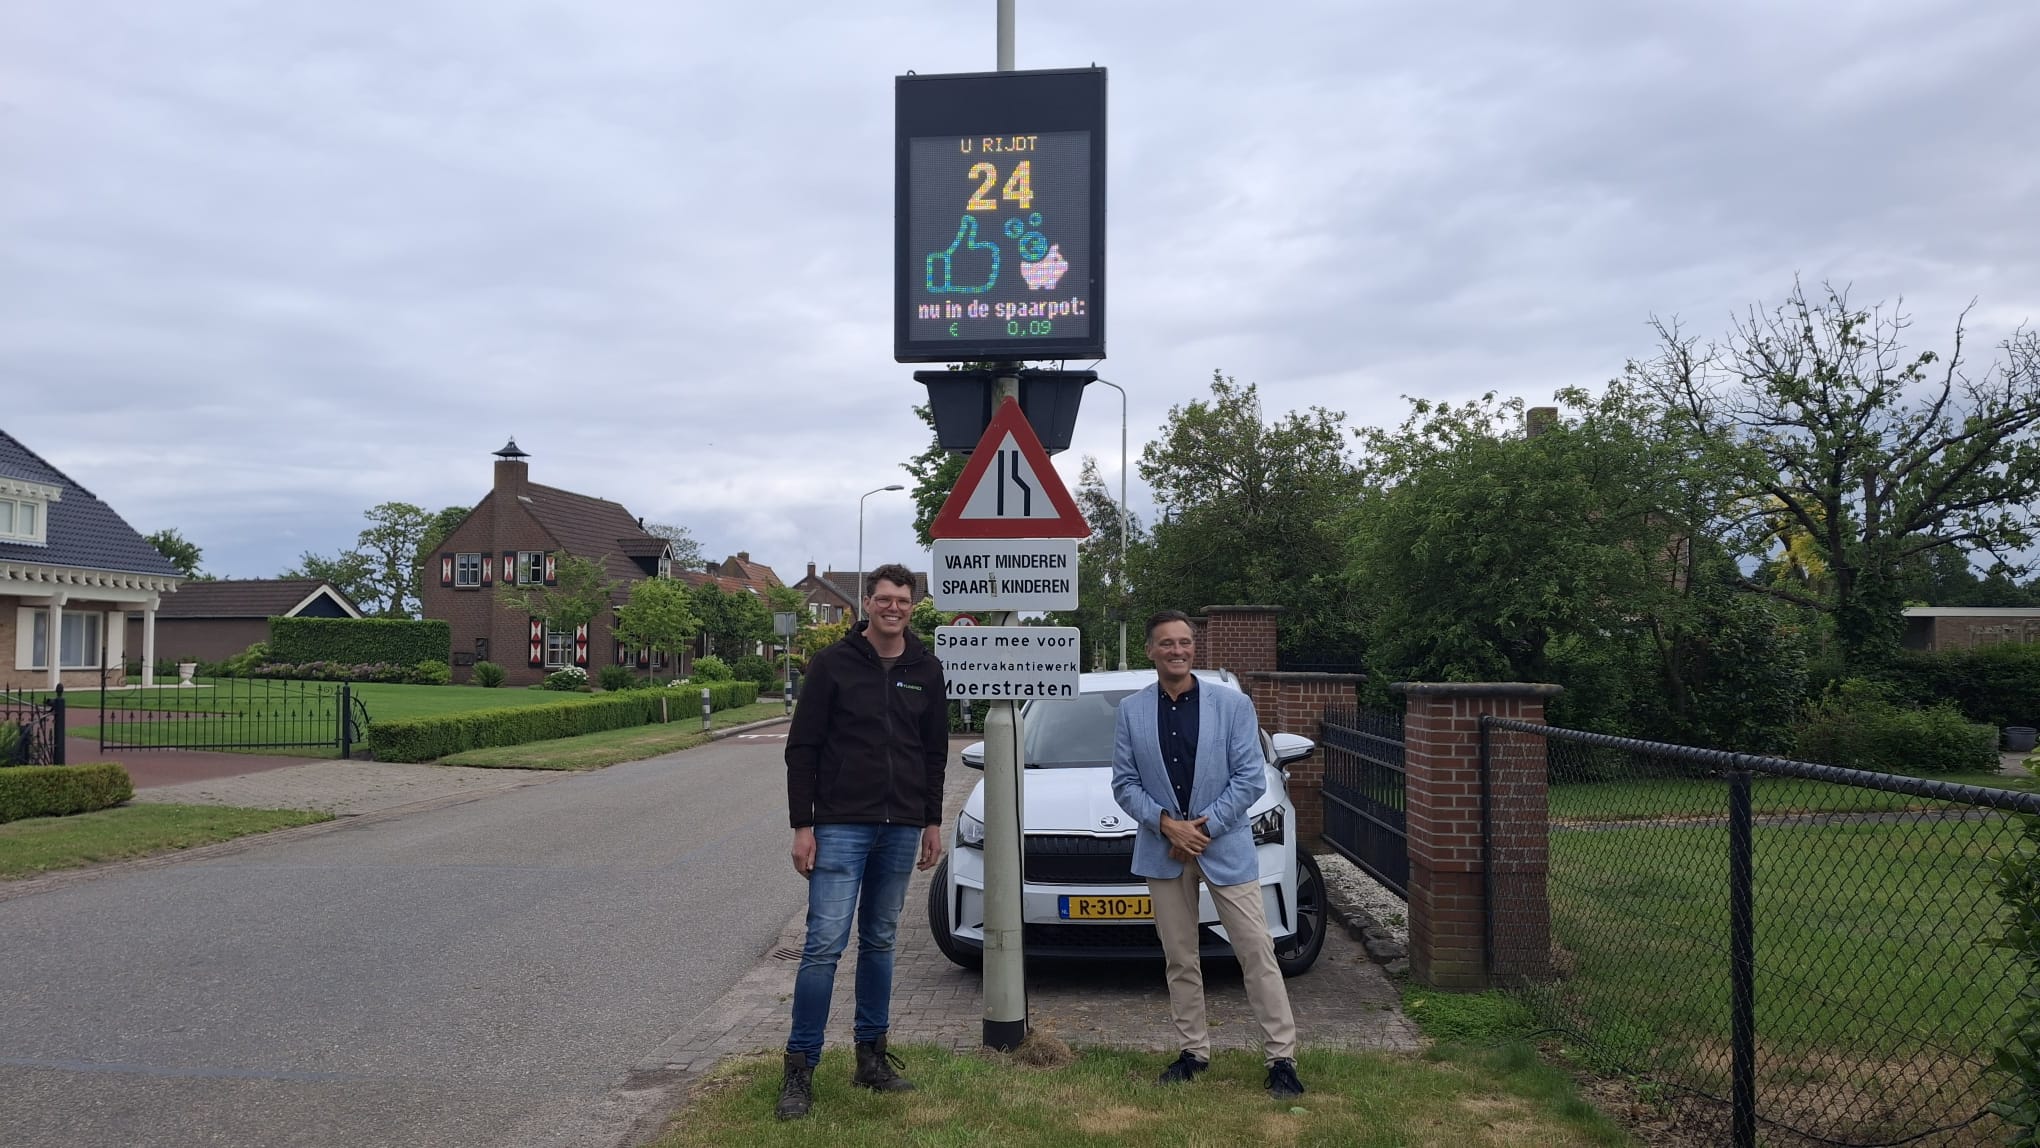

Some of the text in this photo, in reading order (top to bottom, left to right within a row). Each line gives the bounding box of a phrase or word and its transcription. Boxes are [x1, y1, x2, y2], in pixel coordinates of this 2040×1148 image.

[961, 136, 1038, 153] U RIJDT
[966, 160, 1034, 211] 24
[918, 297, 1086, 320] nu in de spaarpot:
[1007, 321, 1052, 337] 0,09
[945, 554, 1067, 569] VAART MINDEREN
[942, 579, 1070, 594] SPAART KINDEREN
[937, 633, 1075, 648] Spaar mee voor
[1080, 899, 1152, 915] R-310-JJ
